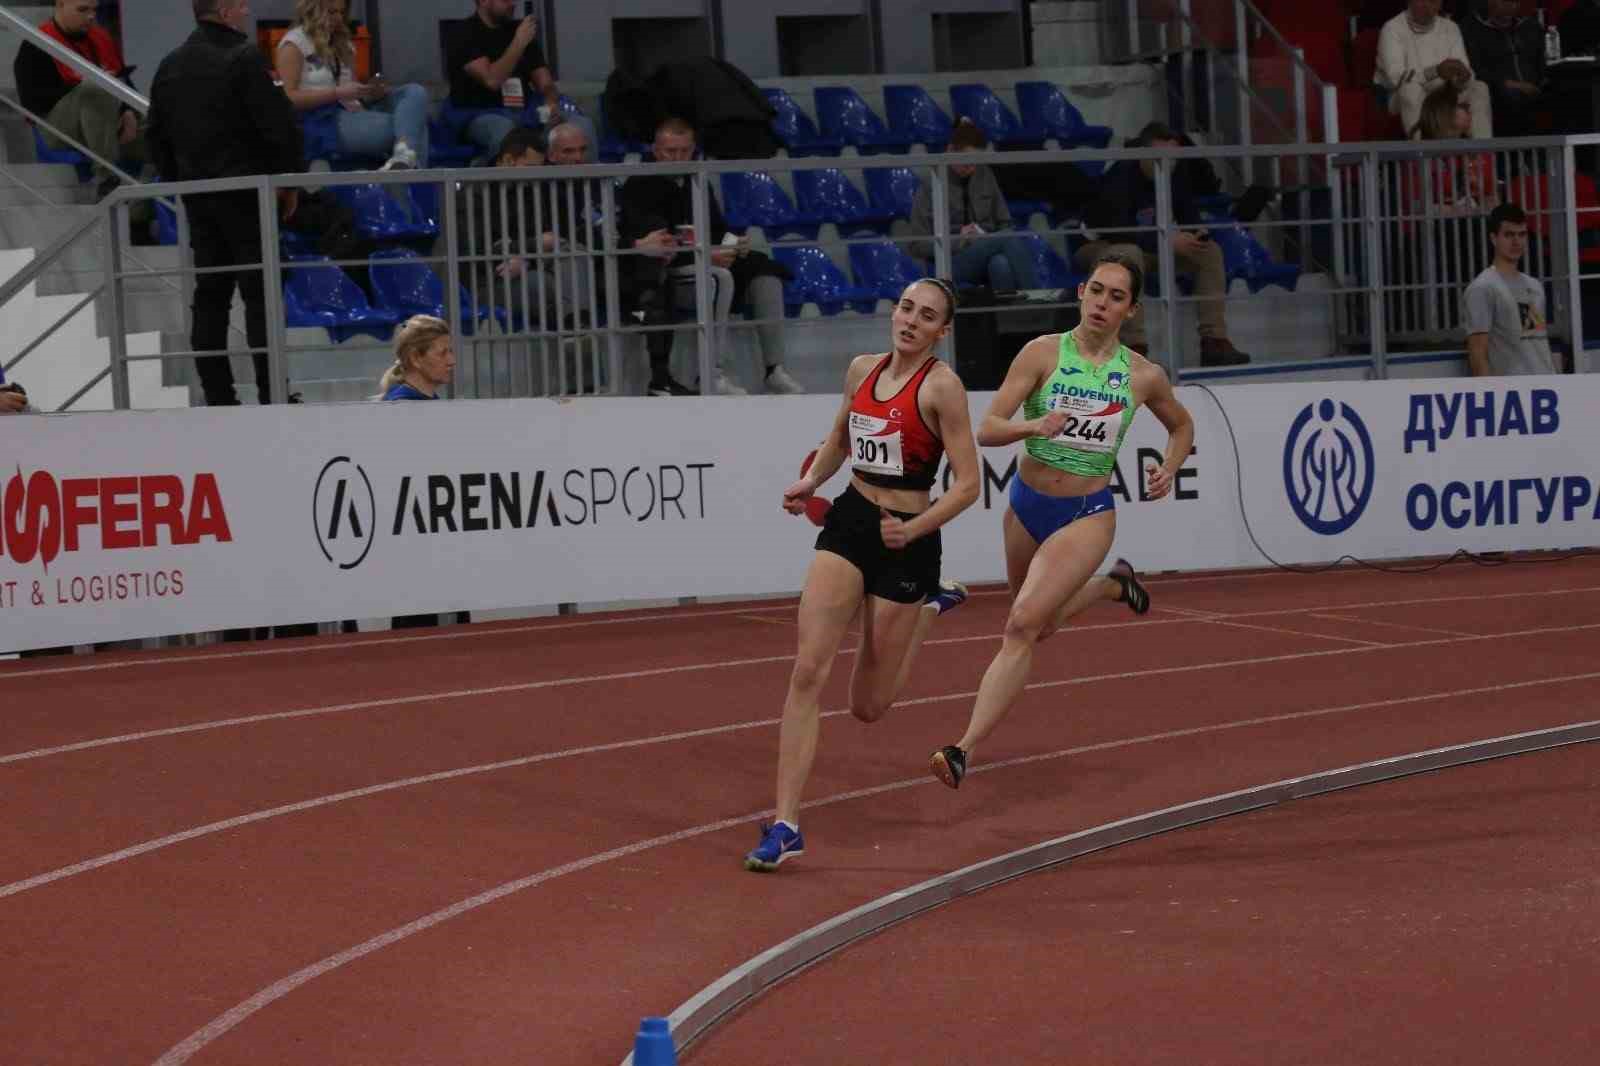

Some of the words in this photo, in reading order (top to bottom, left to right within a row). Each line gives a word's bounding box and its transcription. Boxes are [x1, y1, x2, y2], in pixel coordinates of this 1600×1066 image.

[1063, 416, 1106, 442] 244
[1404, 389, 1560, 453] ДУНАВ
[857, 436, 888, 464] 301
[0, 463, 233, 575] SFERA
[392, 463, 715, 536] ARENASPORT
[1405, 476, 1600, 531] ОСИГУР
[0, 581, 17, 608] T
[31, 580, 45, 606] &
[57, 570, 184, 604] LOGISTICS
